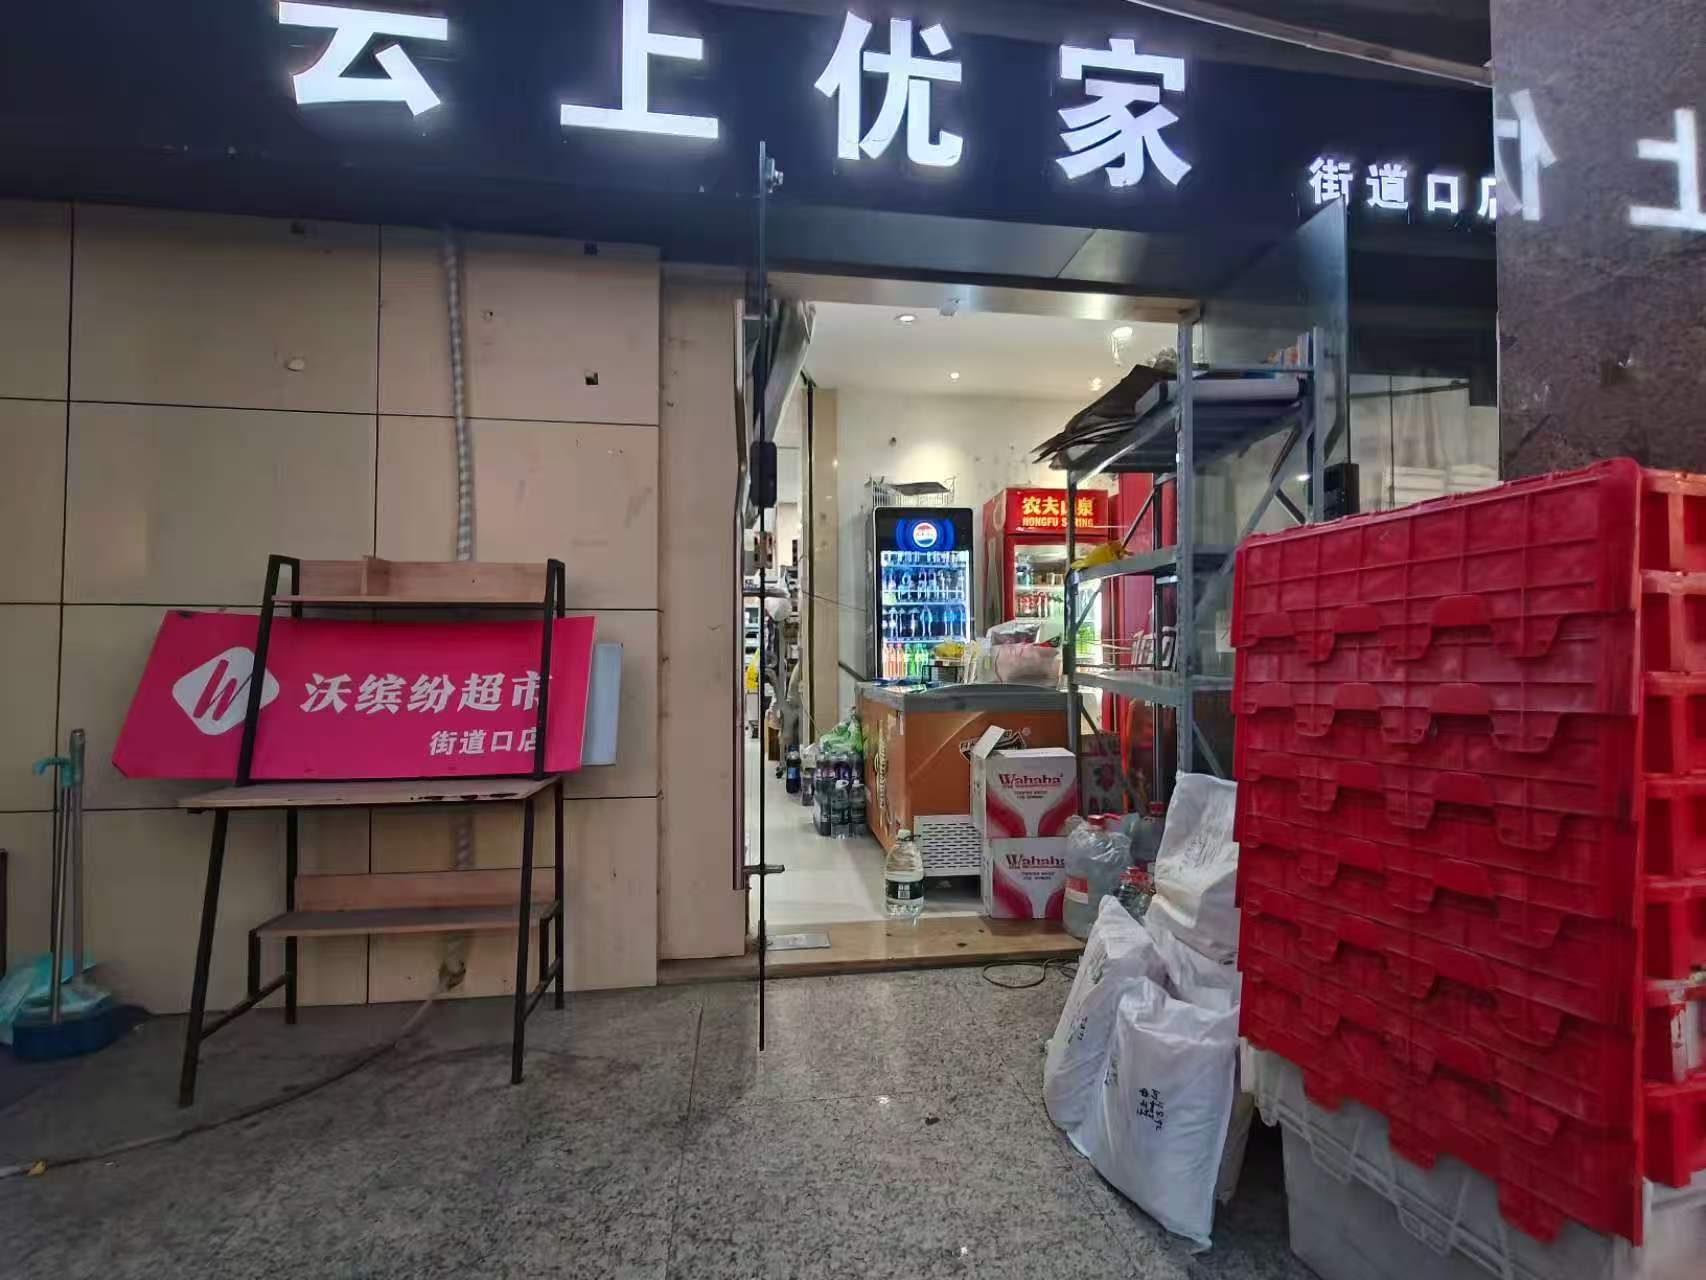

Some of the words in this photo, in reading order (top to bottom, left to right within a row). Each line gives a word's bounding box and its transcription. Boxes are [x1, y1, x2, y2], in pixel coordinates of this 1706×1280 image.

[278, 0, 1193, 187] 云上优家
[300, 670, 552, 714] 沃缤纷超市
[998, 773, 1062, 786] Wahaha
